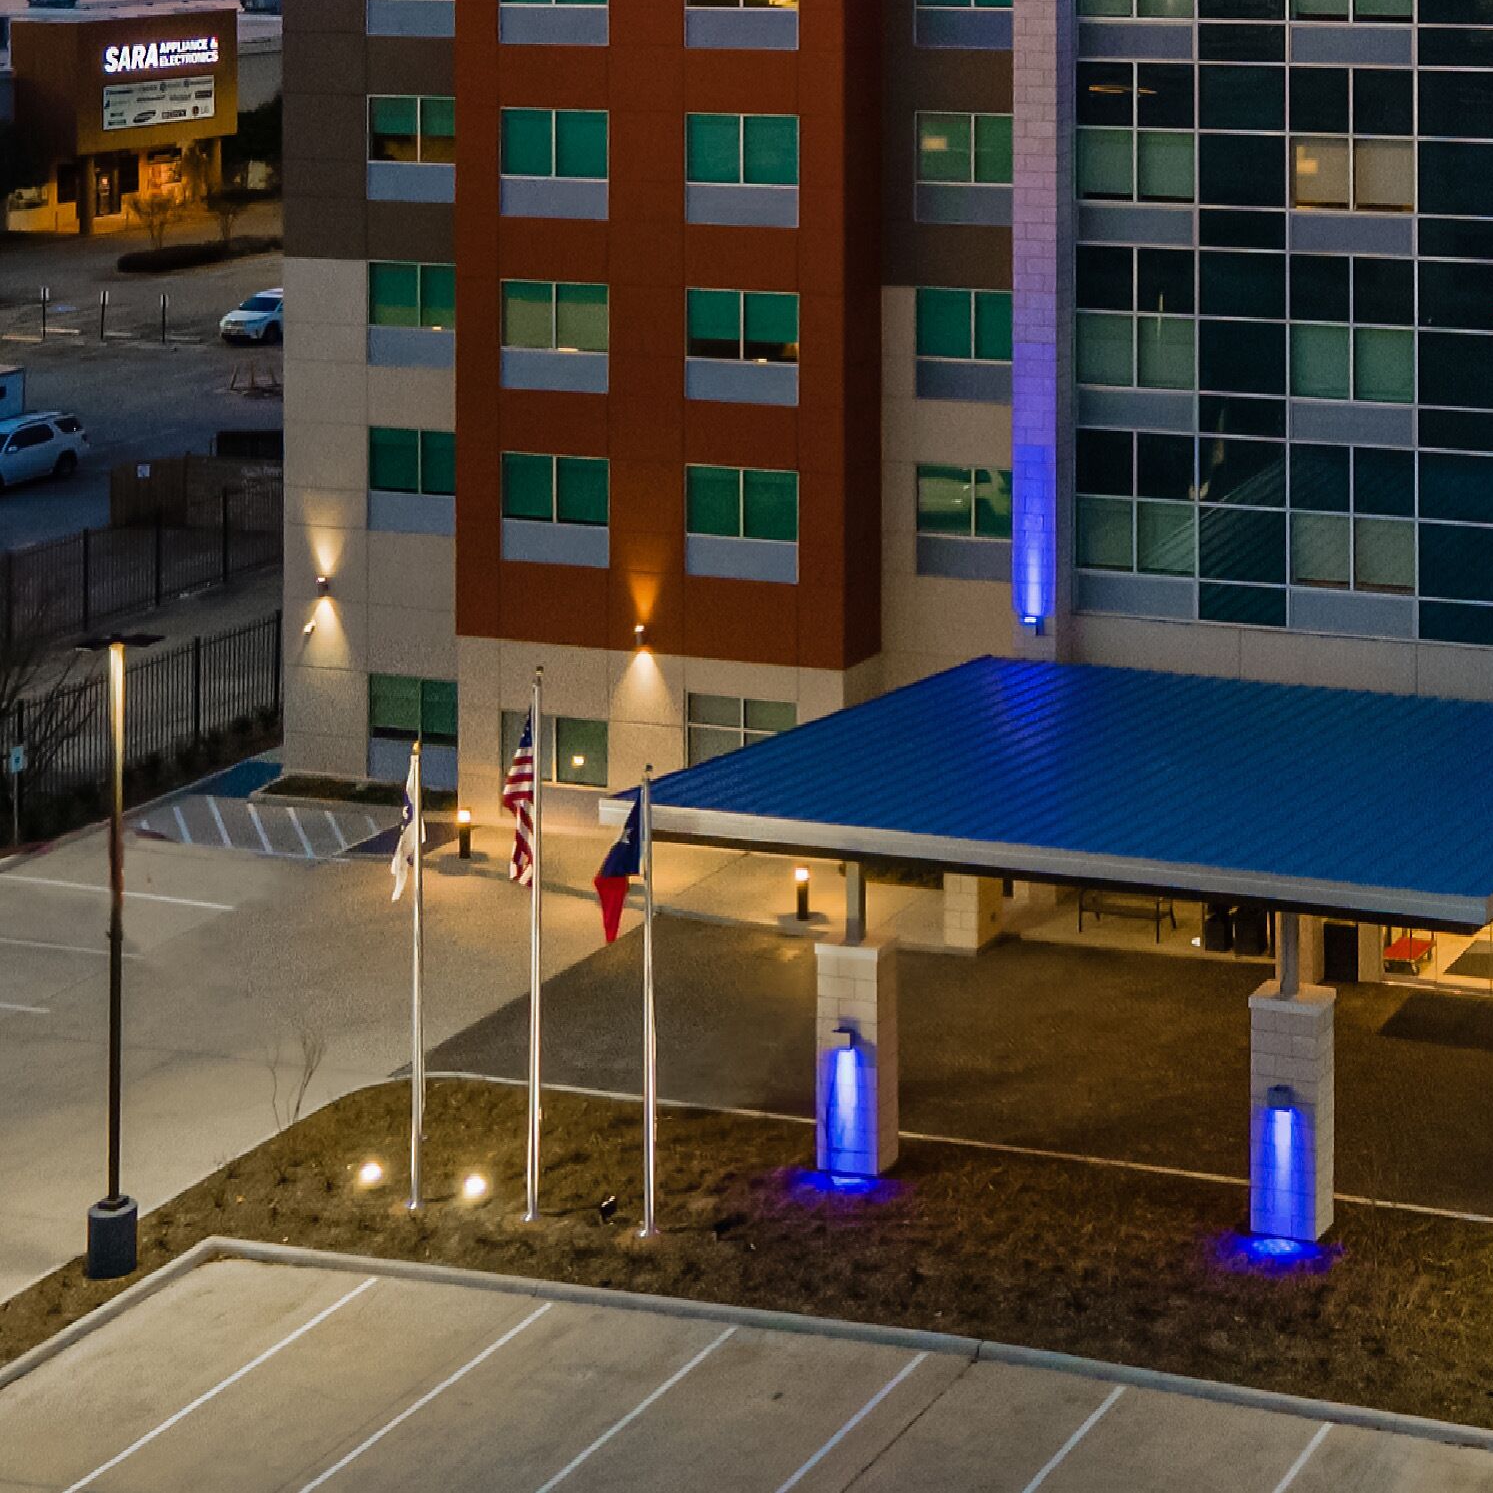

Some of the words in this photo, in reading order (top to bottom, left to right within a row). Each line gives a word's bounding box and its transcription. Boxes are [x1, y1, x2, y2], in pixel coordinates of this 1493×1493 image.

[160, 38, 208, 53] APPLIANCE
[104, 43, 159, 73] SARA
[160, 51, 219, 67] ELECTRONICS
